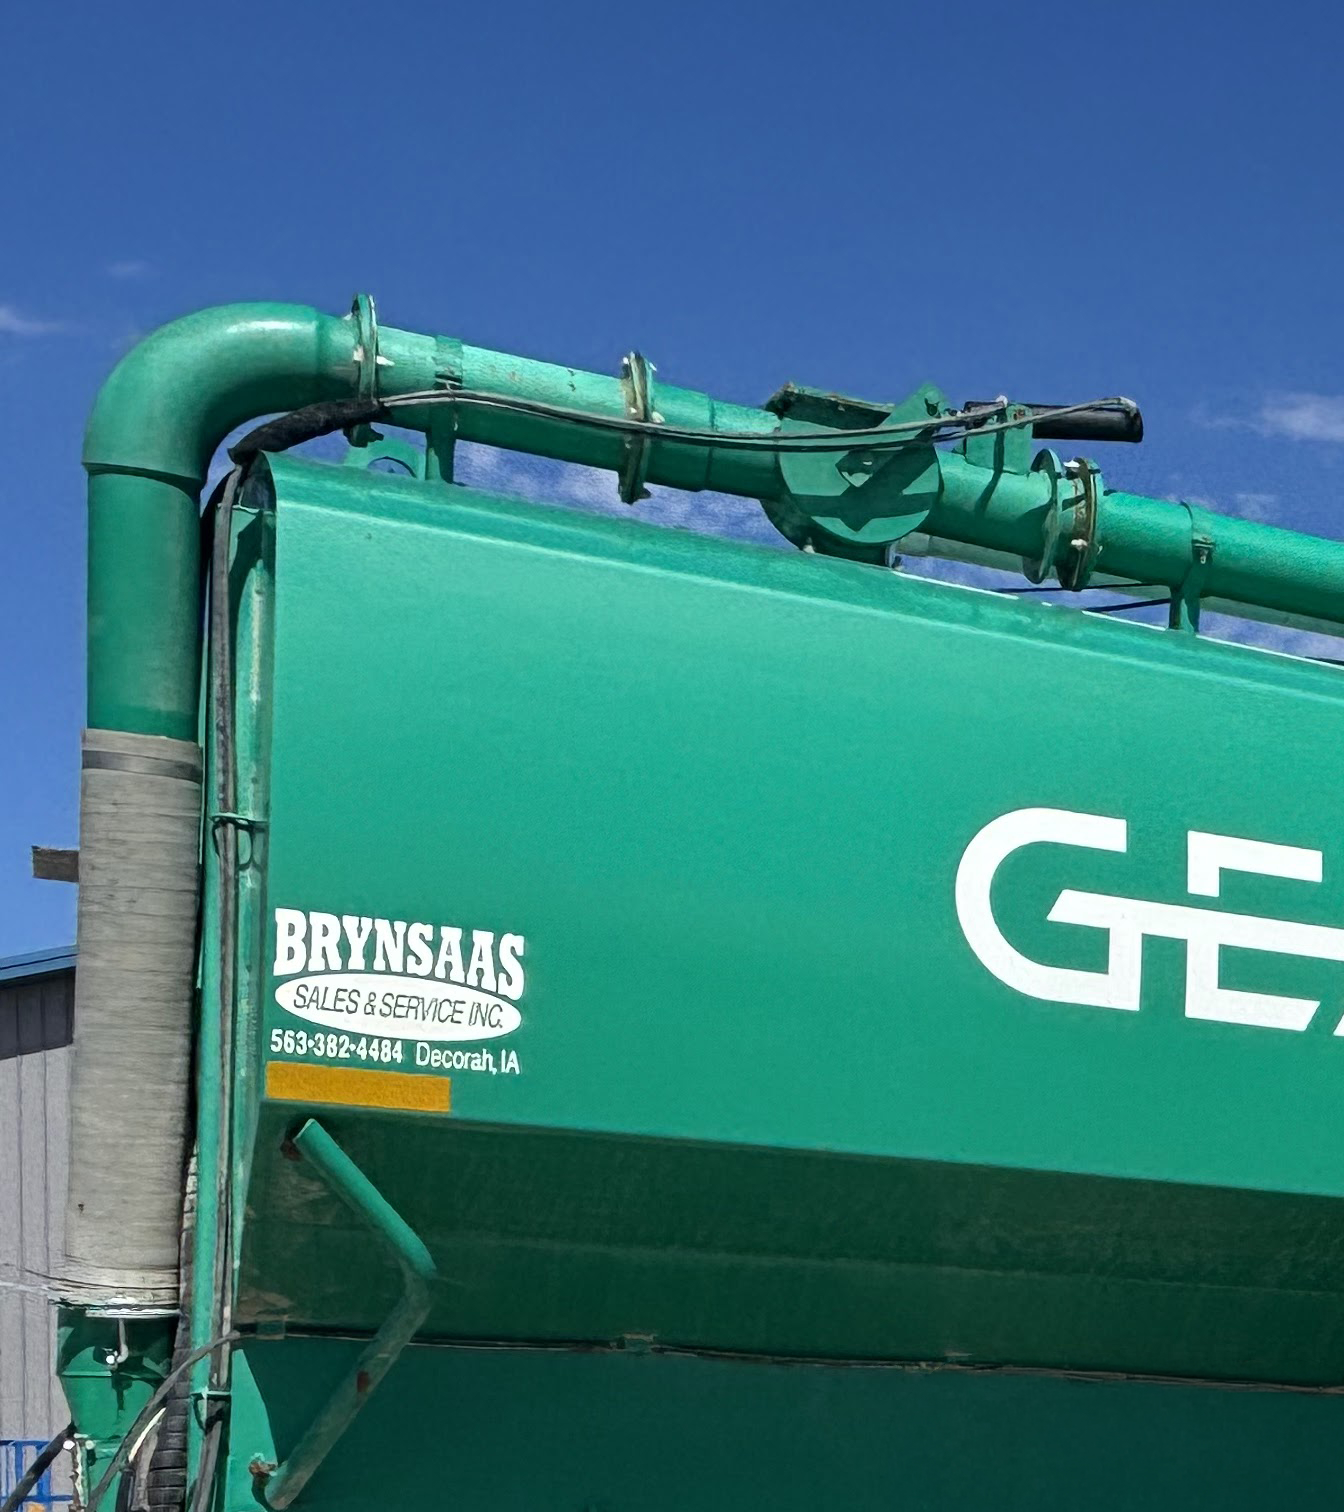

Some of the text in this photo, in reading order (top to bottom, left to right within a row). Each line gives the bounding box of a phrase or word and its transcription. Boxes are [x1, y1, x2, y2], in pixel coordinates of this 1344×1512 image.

[273, 907, 525, 1000] BRYNSAAS
[293, 983, 359, 1015] SALES
[363, 991, 376, 1015] &
[379, 991, 465, 1025] SERVICE
[415, 1041, 498, 1075] Decorah,
[501, 1049, 520, 1075] IA
